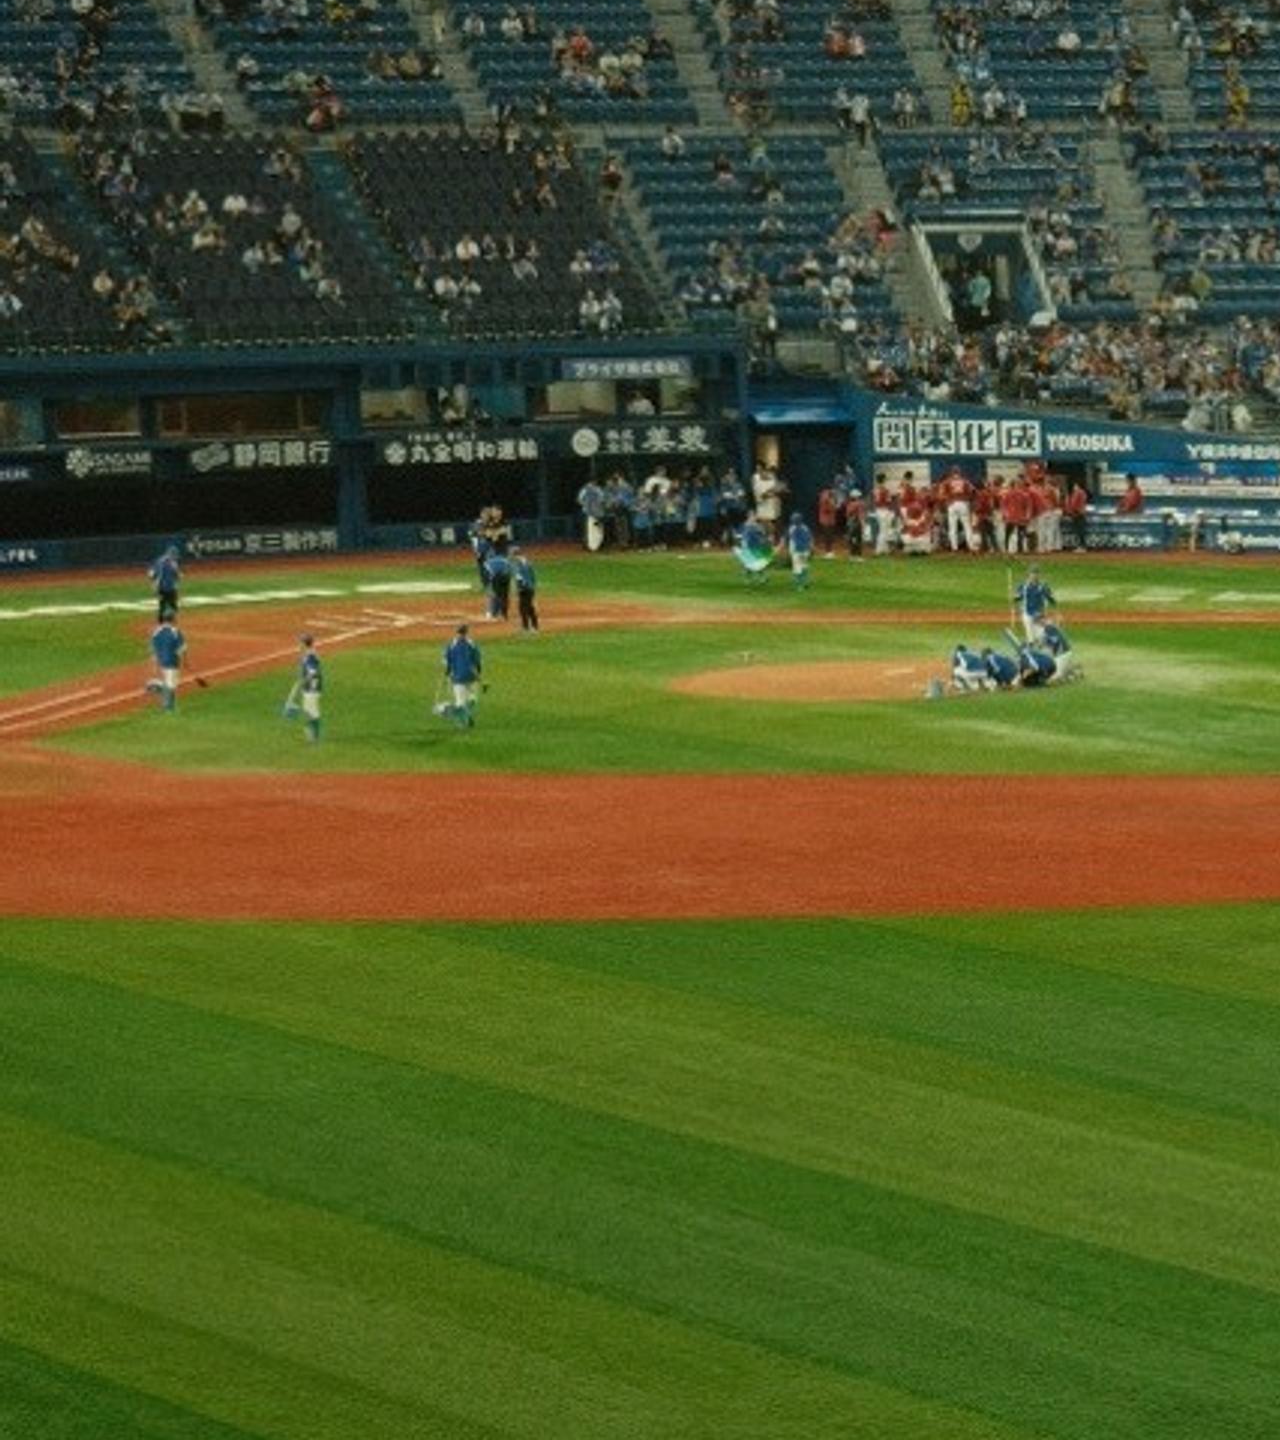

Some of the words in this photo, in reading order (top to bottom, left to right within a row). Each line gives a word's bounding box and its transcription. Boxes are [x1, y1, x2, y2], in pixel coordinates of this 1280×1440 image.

[876, 420, 1039, 453] 関東化成
[1047, 433, 1135, 452] YOKOSUKA
